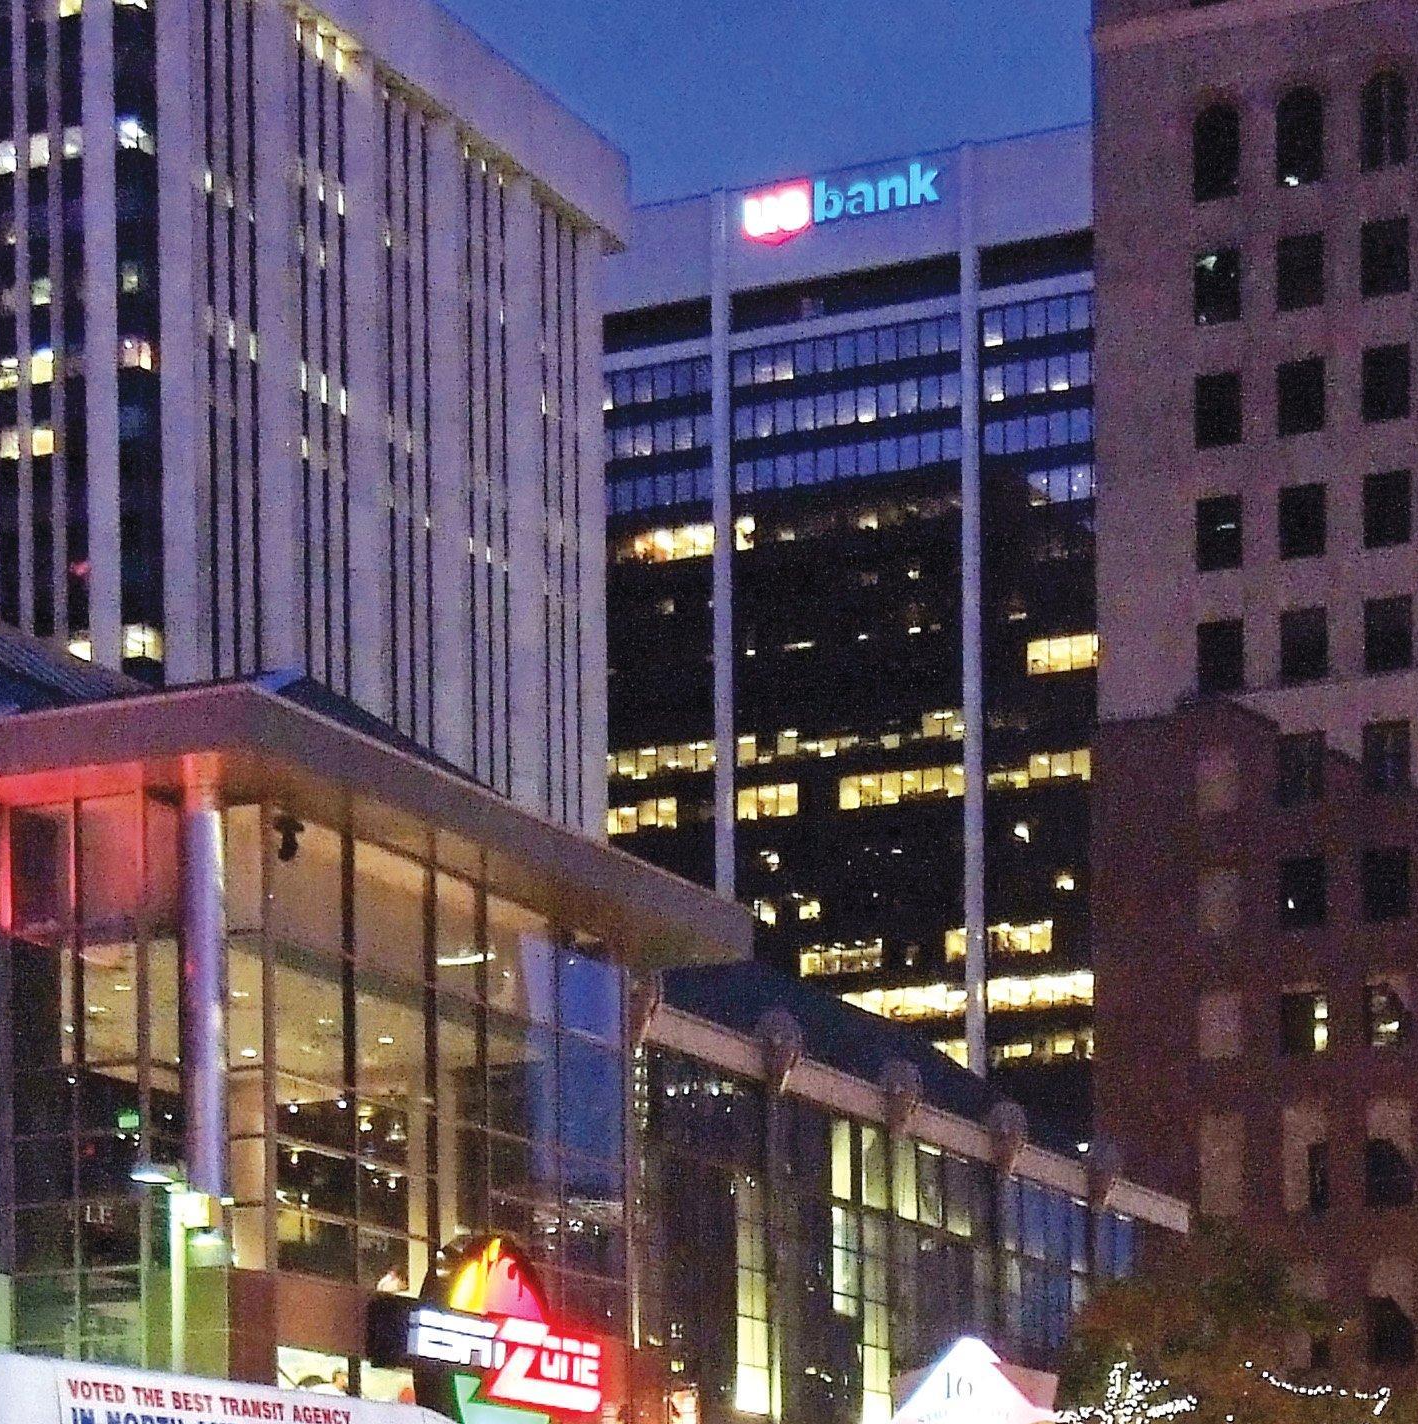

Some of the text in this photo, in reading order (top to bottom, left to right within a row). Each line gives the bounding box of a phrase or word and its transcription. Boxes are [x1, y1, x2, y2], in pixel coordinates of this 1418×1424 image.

[68, 1379, 126, 1404] VOTED
[132, 1386, 164, 1409] THE
[171, 1391, 213, 1414] BEST
[219, 1397, 285, 1422] TRANSIT
